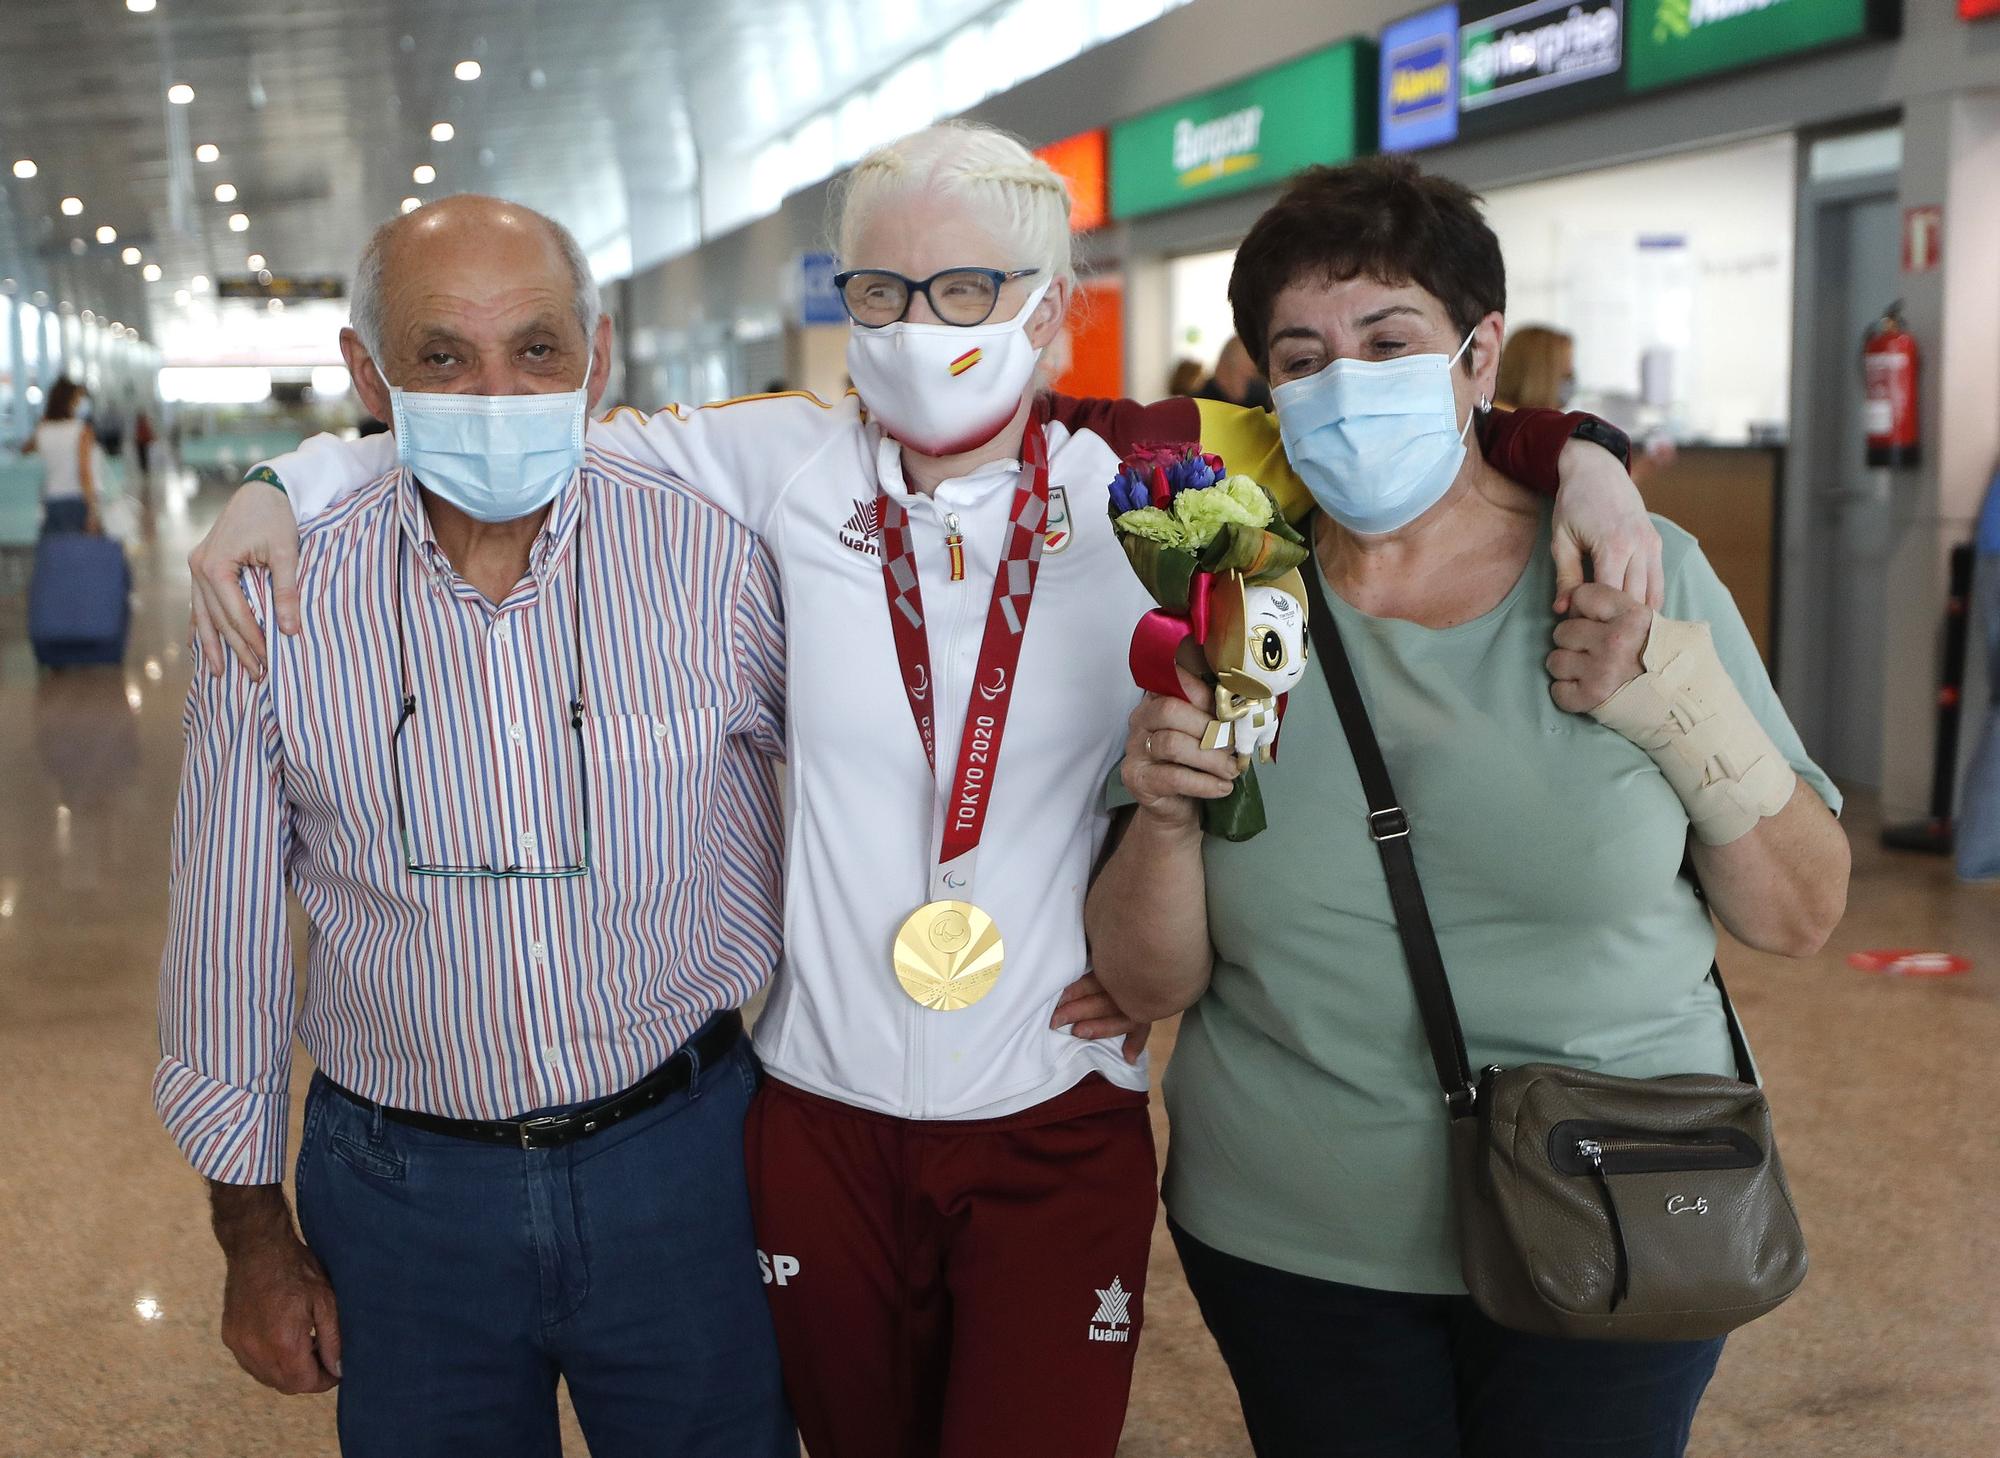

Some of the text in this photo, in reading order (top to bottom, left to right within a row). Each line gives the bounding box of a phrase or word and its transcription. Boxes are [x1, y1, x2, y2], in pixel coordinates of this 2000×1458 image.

[956, 715, 994, 831] TOKYO 2020
[1088, 1324, 1130, 1342] luanvi
